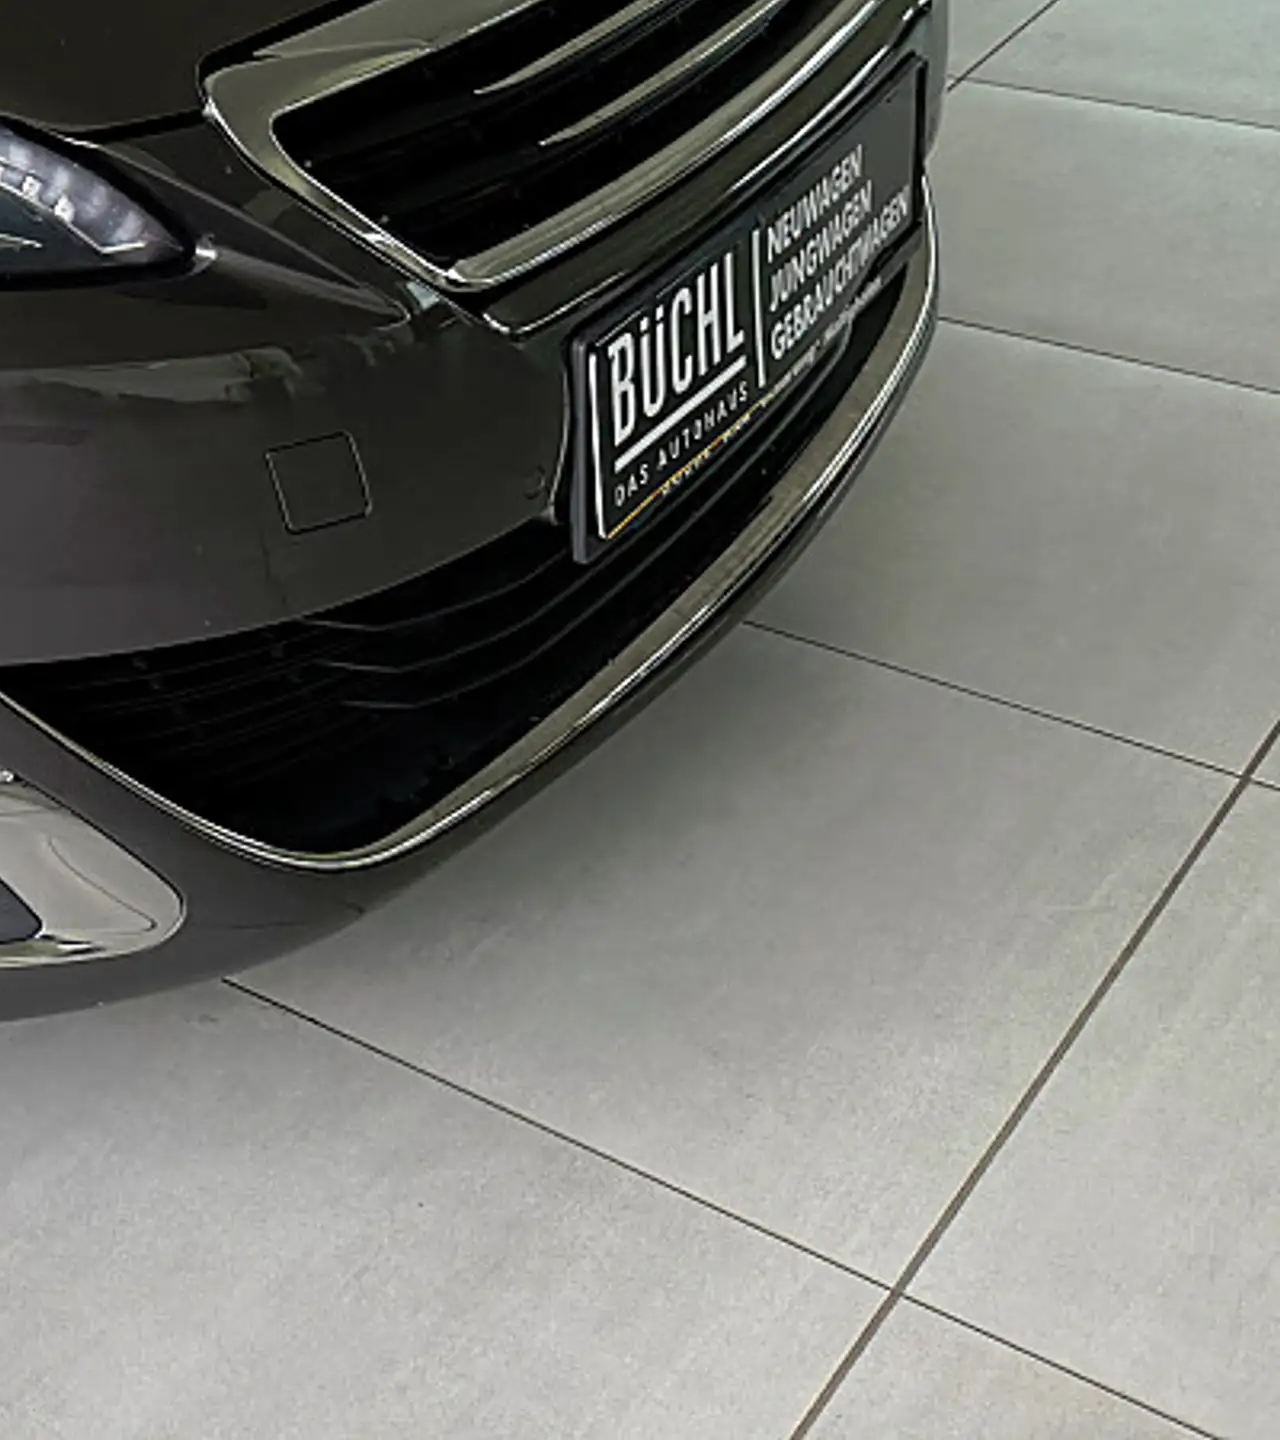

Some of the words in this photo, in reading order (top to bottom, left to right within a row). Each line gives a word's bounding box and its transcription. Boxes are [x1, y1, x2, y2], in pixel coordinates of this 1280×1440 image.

[767, 143, 863, 264] NEUWAGEN
[769, 179, 873, 313] JUNGWAGEN
[607, 251, 746, 448] BÜCHL
[614, 463, 649, 508] DAS
[656, 380, 749, 471] AUTOHAUS
